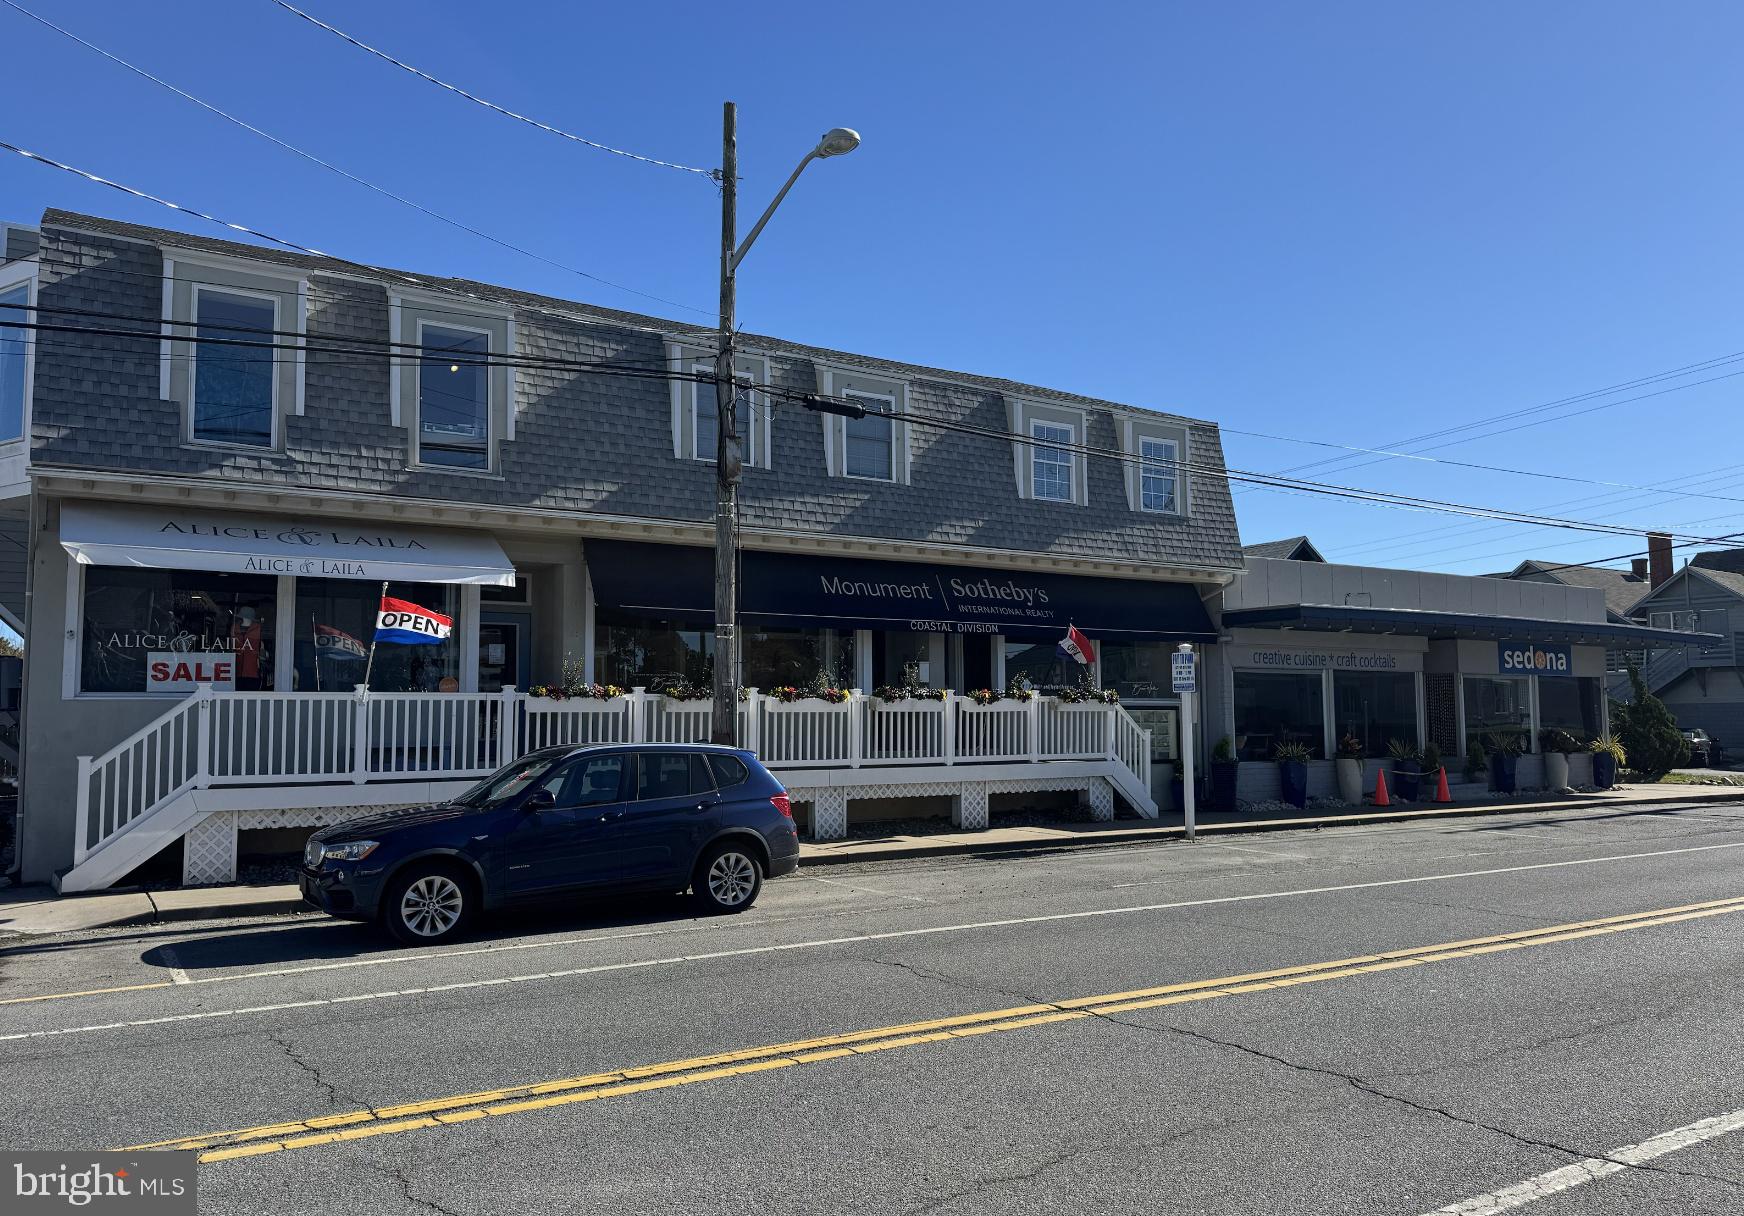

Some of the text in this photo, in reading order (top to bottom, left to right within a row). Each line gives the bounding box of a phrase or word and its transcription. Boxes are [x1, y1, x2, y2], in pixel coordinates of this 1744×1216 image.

[159, 521, 427, 550] ALICE & LAILA
[244, 557, 365, 576] ALICE & LAILA
[820, 575, 933, 600] Monument
[950, 578, 1049, 606] Sotheby's
[958, 605, 1054, 619] INTERNATIONAL REALTY
[381, 613, 440, 635] OPEN
[910, 620, 999, 633] COASTAL DIVISION
[108, 631, 254, 653] ALICE & LAILA
[1253, 650, 1396, 669] creative cuisine craft cocktails
[1503, 648, 1567, 672] sedona
[150, 662, 232, 682] SALE
